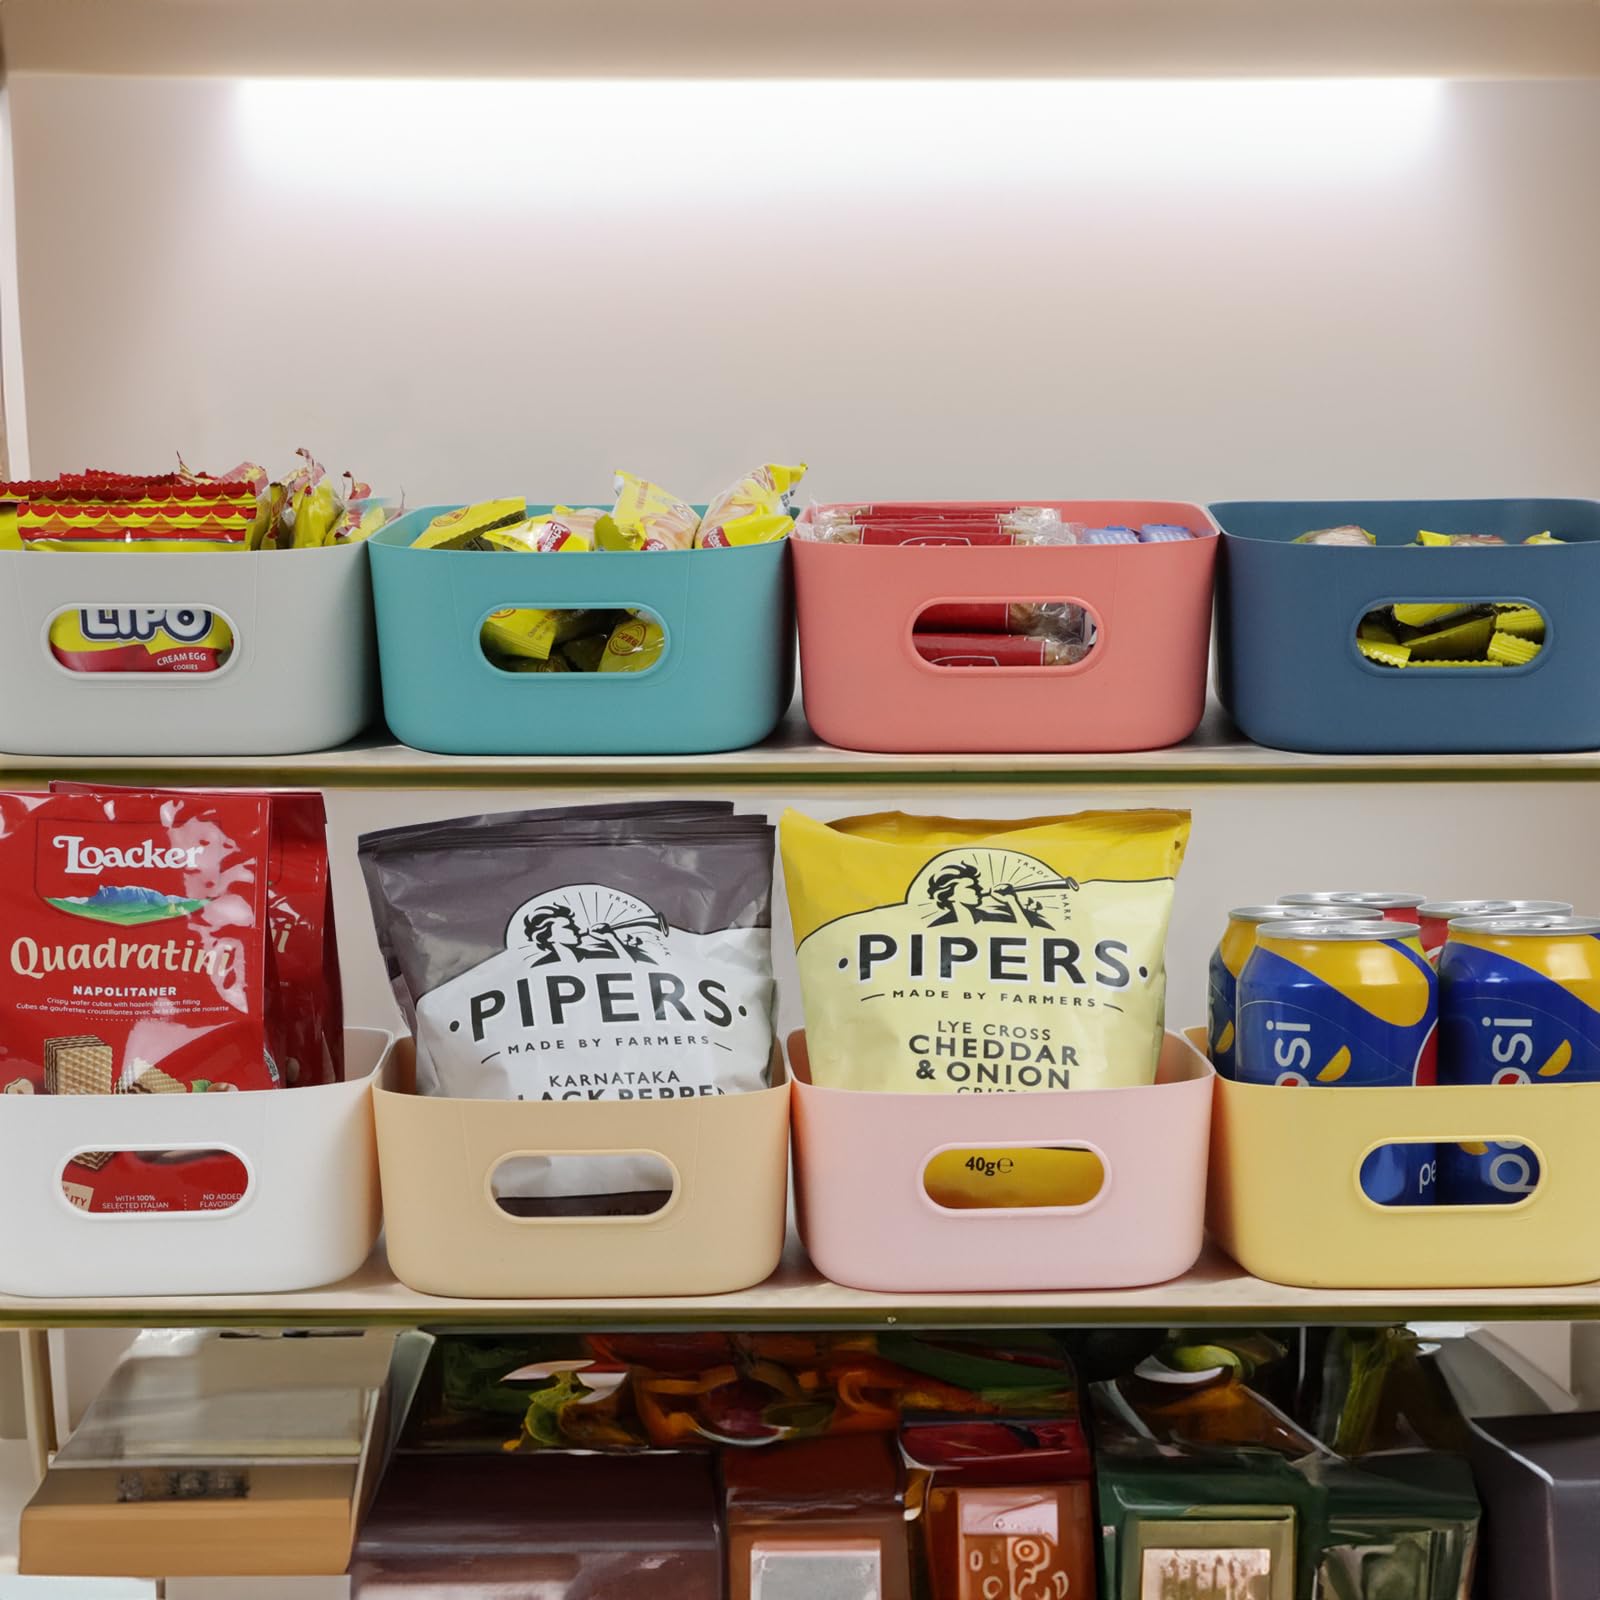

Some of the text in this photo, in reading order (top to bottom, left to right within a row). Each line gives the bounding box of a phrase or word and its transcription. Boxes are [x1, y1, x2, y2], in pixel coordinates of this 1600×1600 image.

[157, 652, 206, 666] CREAM EGG
[53, 835, 204, 875] Loacker
[1017, 859, 1050, 879] TRADE
[608, 893, 643, 913] TRADE
[1061, 893, 1072, 921] MARK
[10, 936, 230, 979] Quadratini
[859, 933, 1130, 988] PIPERS
[73, 985, 177, 997] NAPOLITANER
[893, 989, 1096, 1008] MADE BY FARMERS
[16, 1002, 37, 1010] Cubes
[50, 1005, 86, 1014] gaufrettes
[47, 997, 69, 1006] Crispy
[113, 1000, 128, 1008] with
[470, 972, 732, 1042] PIPERS
[938, 1020, 1051, 1041] LYE CROSS
[508, 1034, 709, 1055] MADE BY FARMERS
[909, 1034, 1080, 1066] CHEDDAR
[549, 1070, 680, 1087] KARNATAKA
[916, 1059, 1070, 1090] & ONION
[141, 1201, 169, 1209] ITALIAN
[203, 1193, 215, 1201] NO
